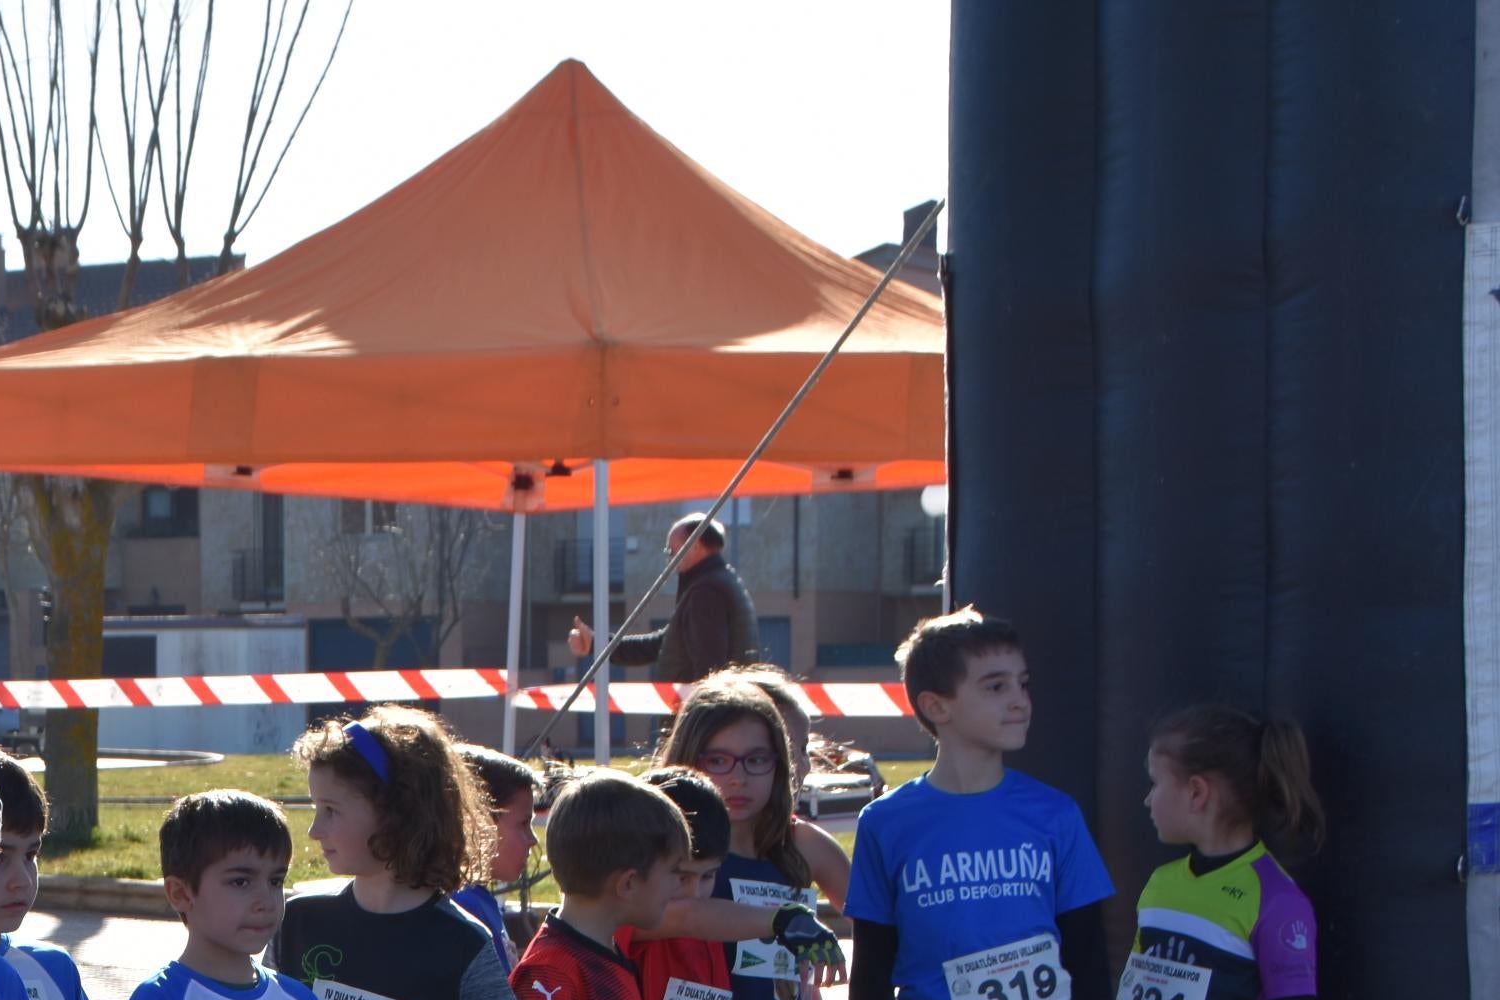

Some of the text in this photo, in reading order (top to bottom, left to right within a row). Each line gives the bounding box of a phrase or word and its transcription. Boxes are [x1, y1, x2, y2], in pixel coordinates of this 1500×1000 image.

[902, 842, 1051, 893] LA ARMUÑA
[917, 888, 955, 908] CLUB
[324, 988, 333, 1000] IV
